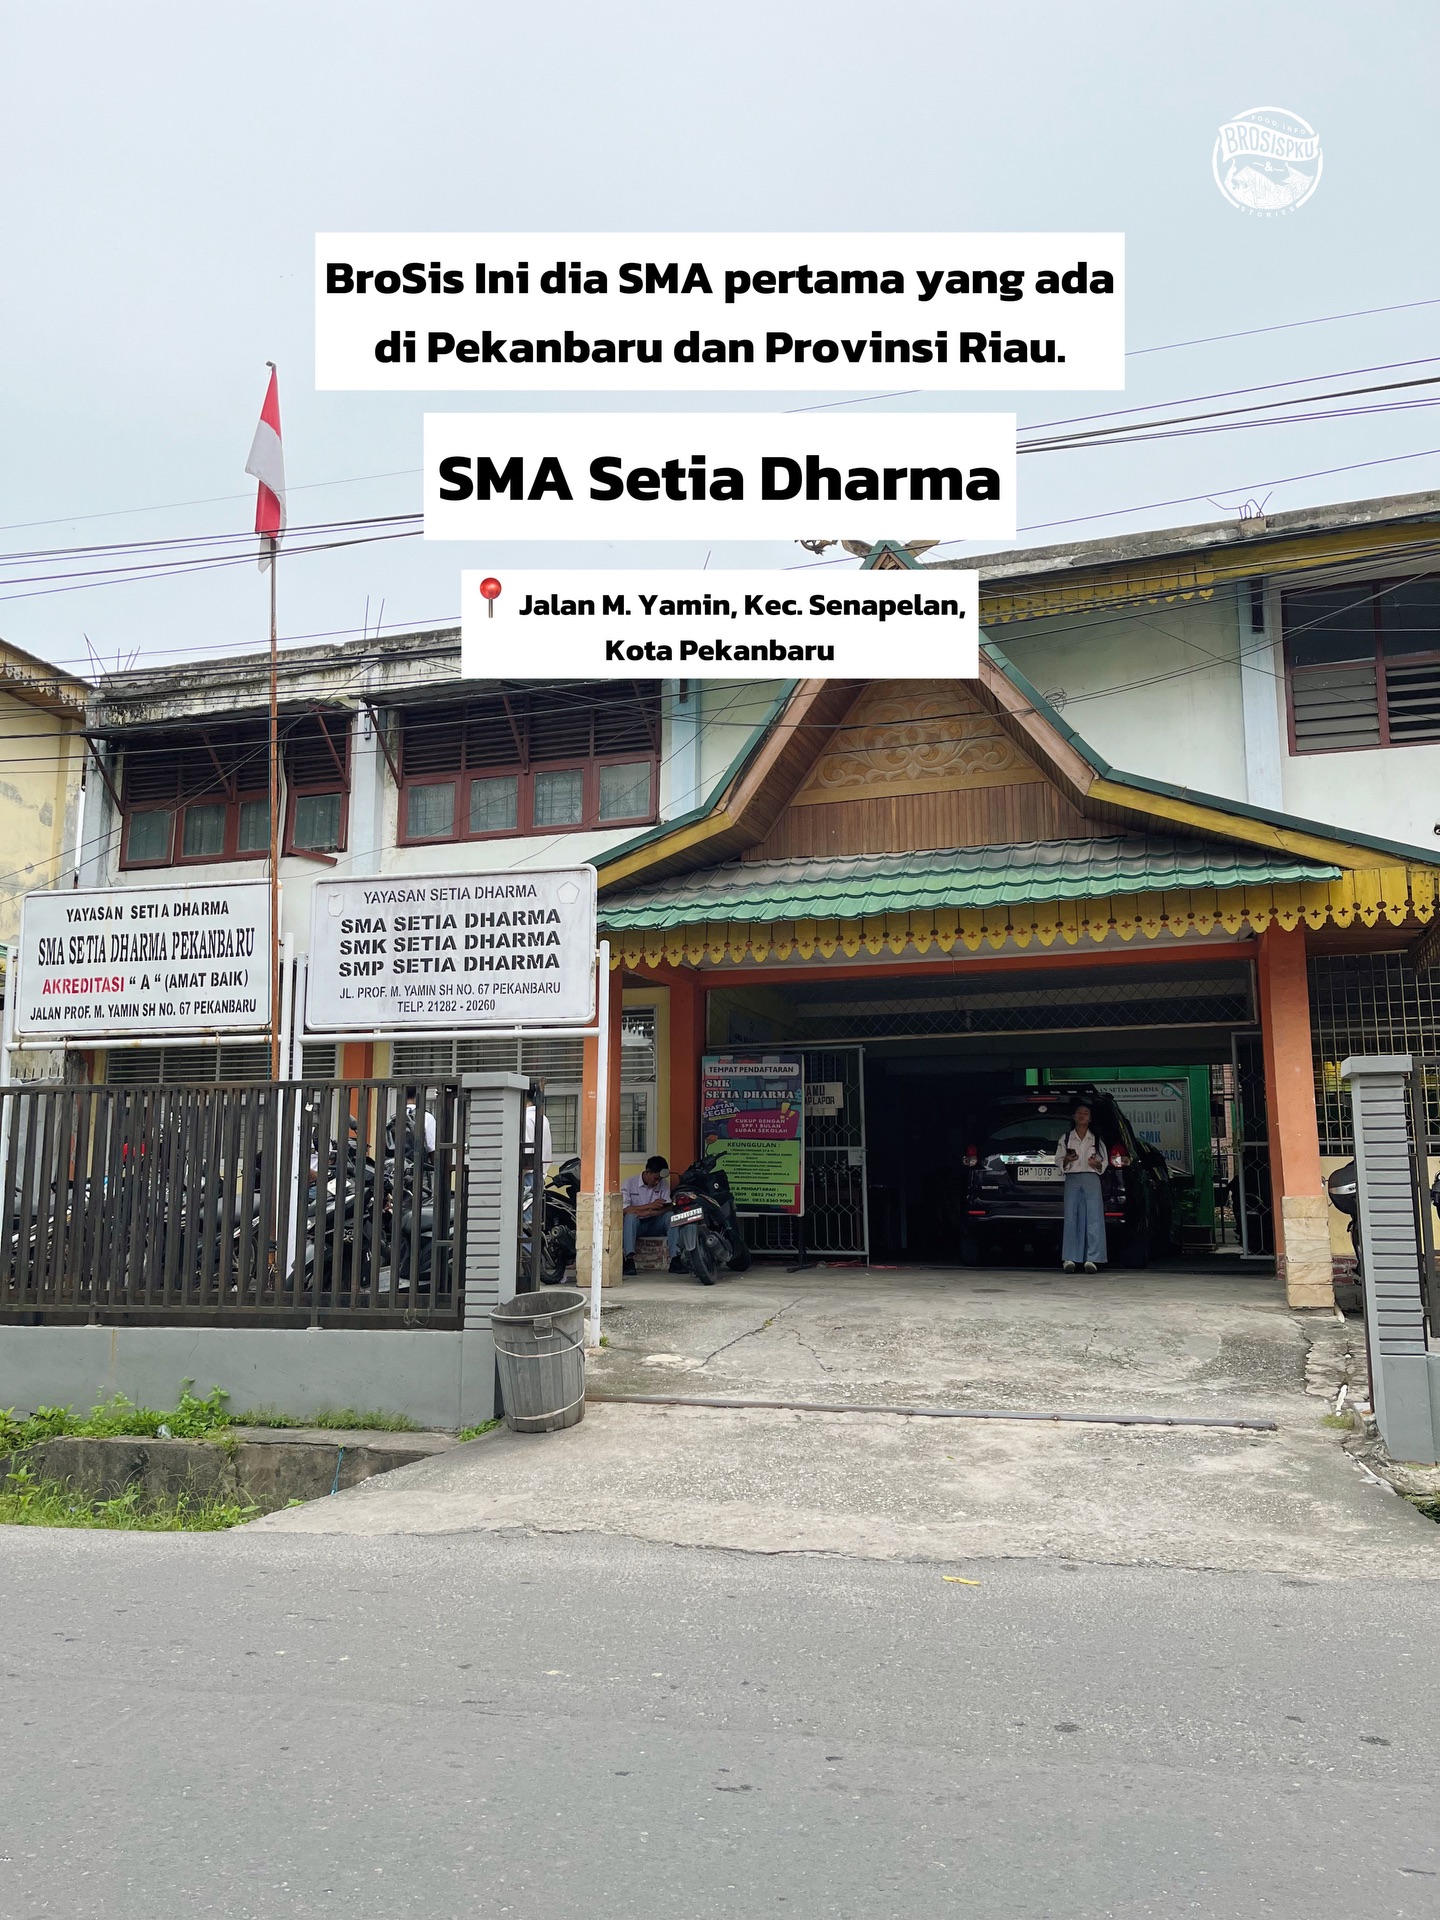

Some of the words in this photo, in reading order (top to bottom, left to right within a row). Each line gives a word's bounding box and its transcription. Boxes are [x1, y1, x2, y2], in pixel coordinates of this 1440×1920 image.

[364, 888, 426, 904] YAYASAN
[430, 886, 471, 902] SETIA
[475, 884, 537, 899] DHARMA
[66, 906, 123, 923] YAYASAN
[130, 903, 170, 919] SETIA
[173, 900, 229, 917] DHARMA
[340, 917, 387, 934] SMA
[393, 914, 457, 932] SETIA
[464, 908, 561, 929] DHARMA
[38, 937, 65, 966] SMA
[68, 934, 106, 965] SETIA
[110, 931, 168, 963] DHARMA
[171, 927, 255, 960] PEKANBARU
[339, 938, 387, 956] SMK
[393, 935, 457, 953] SETIA
[464, 930, 561, 950] DHARMA
[338, 960, 385, 978] SMP
[392, 957, 456, 975] SETIA
[463, 953, 560, 972] DHARMA
[42, 976, 125, 994] AKREDITASI
[140, 974, 150, 990] A
[164, 972, 207, 993] (AMAT
[210, 969, 249, 988] BAIK)
[339, 987, 354, 1000] JL.
[357, 986, 387, 999] PROF.
[390, 985, 401, 998] M.
[404, 984, 436, 997] YAMIN
[439, 984, 454, 996] SH
[456, 983, 475, 995] NO.
[477, 983, 490, 995] 67
[492, 982, 561, 995] PEKANBARU
[30, 1006, 61, 1021] JALAN
[64, 1005, 91, 1020] PROF.
[94, 1004, 105, 1019] M.
[108, 1003, 139, 1018] YAMIN
[142, 1002, 156, 1017] SH
[159, 1001, 176, 1016] NO.
[179, 1001, 191, 1015] 67
[194, 998, 257, 1015] PEKANBARU
[397, 1001, 425, 1013] TELP.
[427, 1000, 457, 1012] 21282
[466, 999, 496, 1011] 20260
[705, 1079, 731, 1088] SMK
[705, 1090, 740, 1099] SETIA
[743, 1090, 795, 1099] DHARMA
[702, 1107, 740, 1118] SEGERA
[705, 1102, 735, 1111] DAFTAR
[1165, 1108, 1176, 1123] di
[1139, 1131, 1161, 1143] SMK
[1019, 1167, 1029, 1176] BM
[1035, 1167, 1052, 1176] 1078
